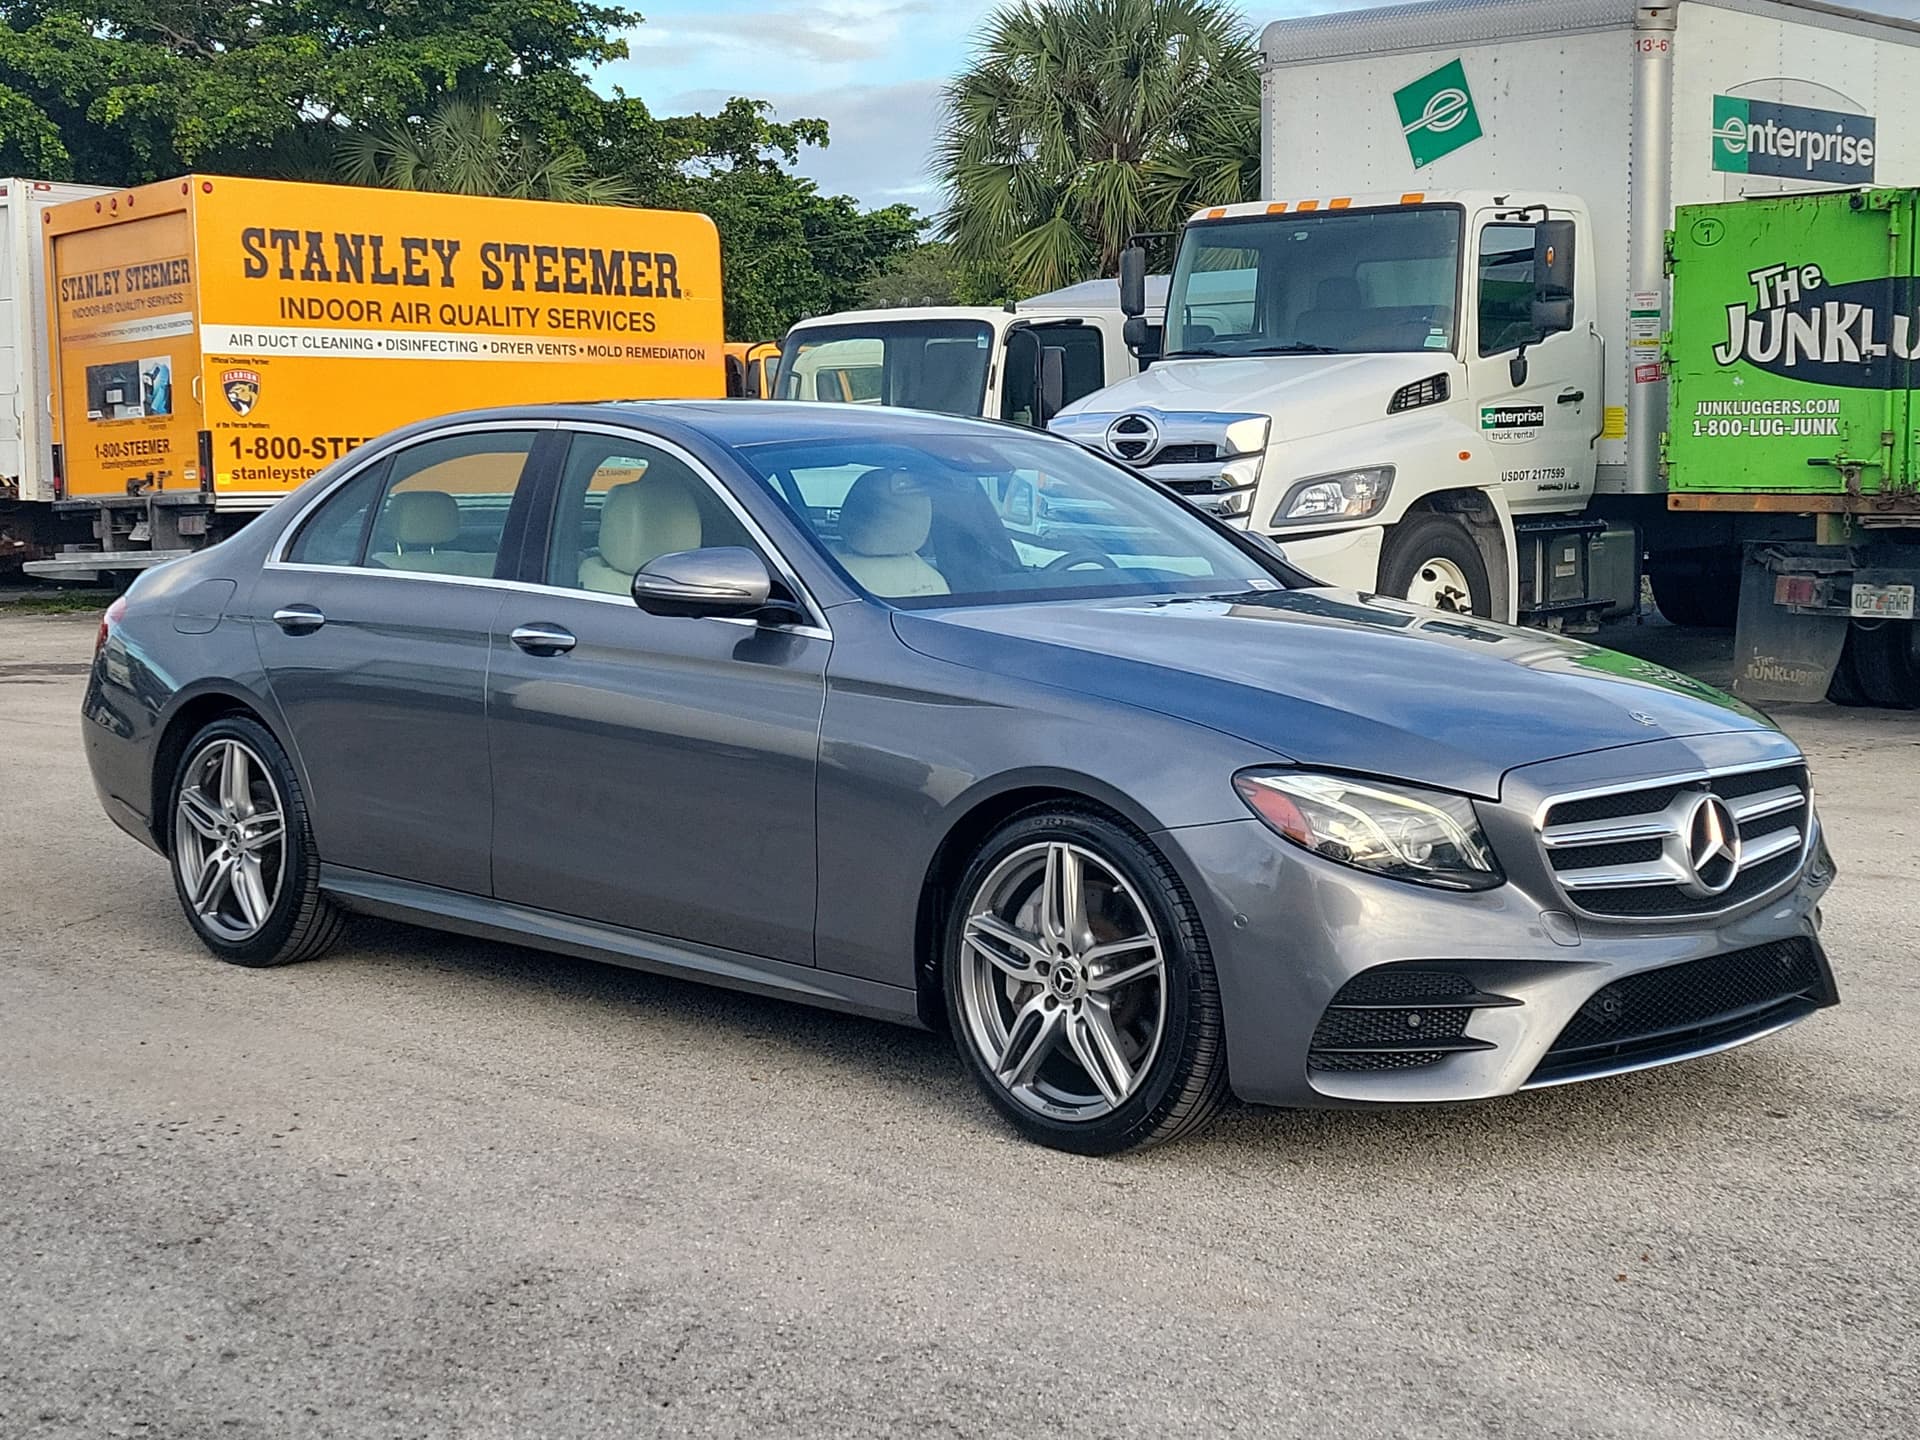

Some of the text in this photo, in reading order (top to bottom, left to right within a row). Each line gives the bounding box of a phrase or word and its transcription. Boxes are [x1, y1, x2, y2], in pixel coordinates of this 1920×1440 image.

[1713, 117, 1874, 171] enterprise
[1704, 230, 1710, 242] 1
[242, 227, 682, 299] STANLEY STEEMER
[62, 259, 191, 302] STANLEY STEEMER
[72, 292, 183, 319] INDOOR AIR QUALITY SERVICES
[280, 297, 656, 332] INDOOR AIR QUALITY SERVICES
[228, 333, 705, 360] AIR DUCT CLEANING DISINFECTING DRYER VENTS MOLD REMEDIATION
[1695, 399, 1840, 415] JUNKLUGGERS.COM
[1482, 409, 1543, 425] enterprise
[1492, 430, 1535, 440] truck rental
[1693, 418, 1839, 436] 1-800-LUG-JUNK
[95, 439, 170, 458] 1-800-STEEMER
[230, 436, 375, 460] 1-800-STE
[232, 465, 322, 482] stanleyste
[1501, 467, 1565, 482] USDOT 2177599
